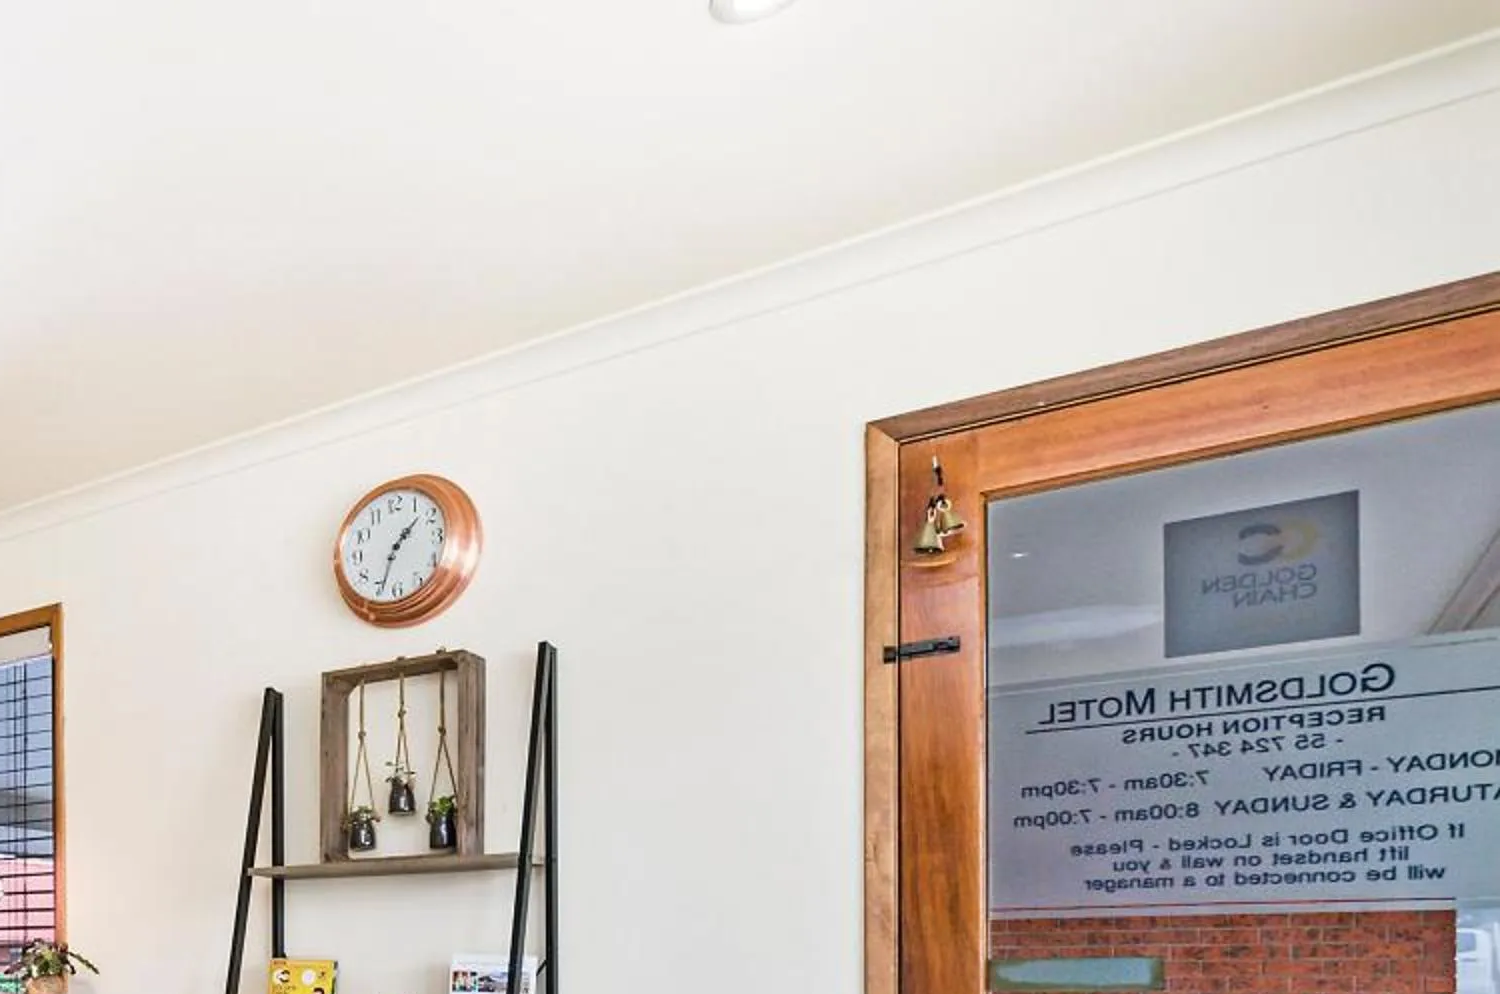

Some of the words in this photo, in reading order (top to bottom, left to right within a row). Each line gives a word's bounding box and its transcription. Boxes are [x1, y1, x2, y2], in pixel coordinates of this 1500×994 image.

[387, 495, 403, 515] 12
[412, 496, 418, 513] 1
[370, 507, 381, 527] 11
[425, 507, 437, 525] 2
[356, 527, 372, 545] 10
[430, 527, 443, 545] 3
[351, 549, 363, 567] 9
[358, 568, 369, 585] 8
[391, 580, 403, 598] 6
